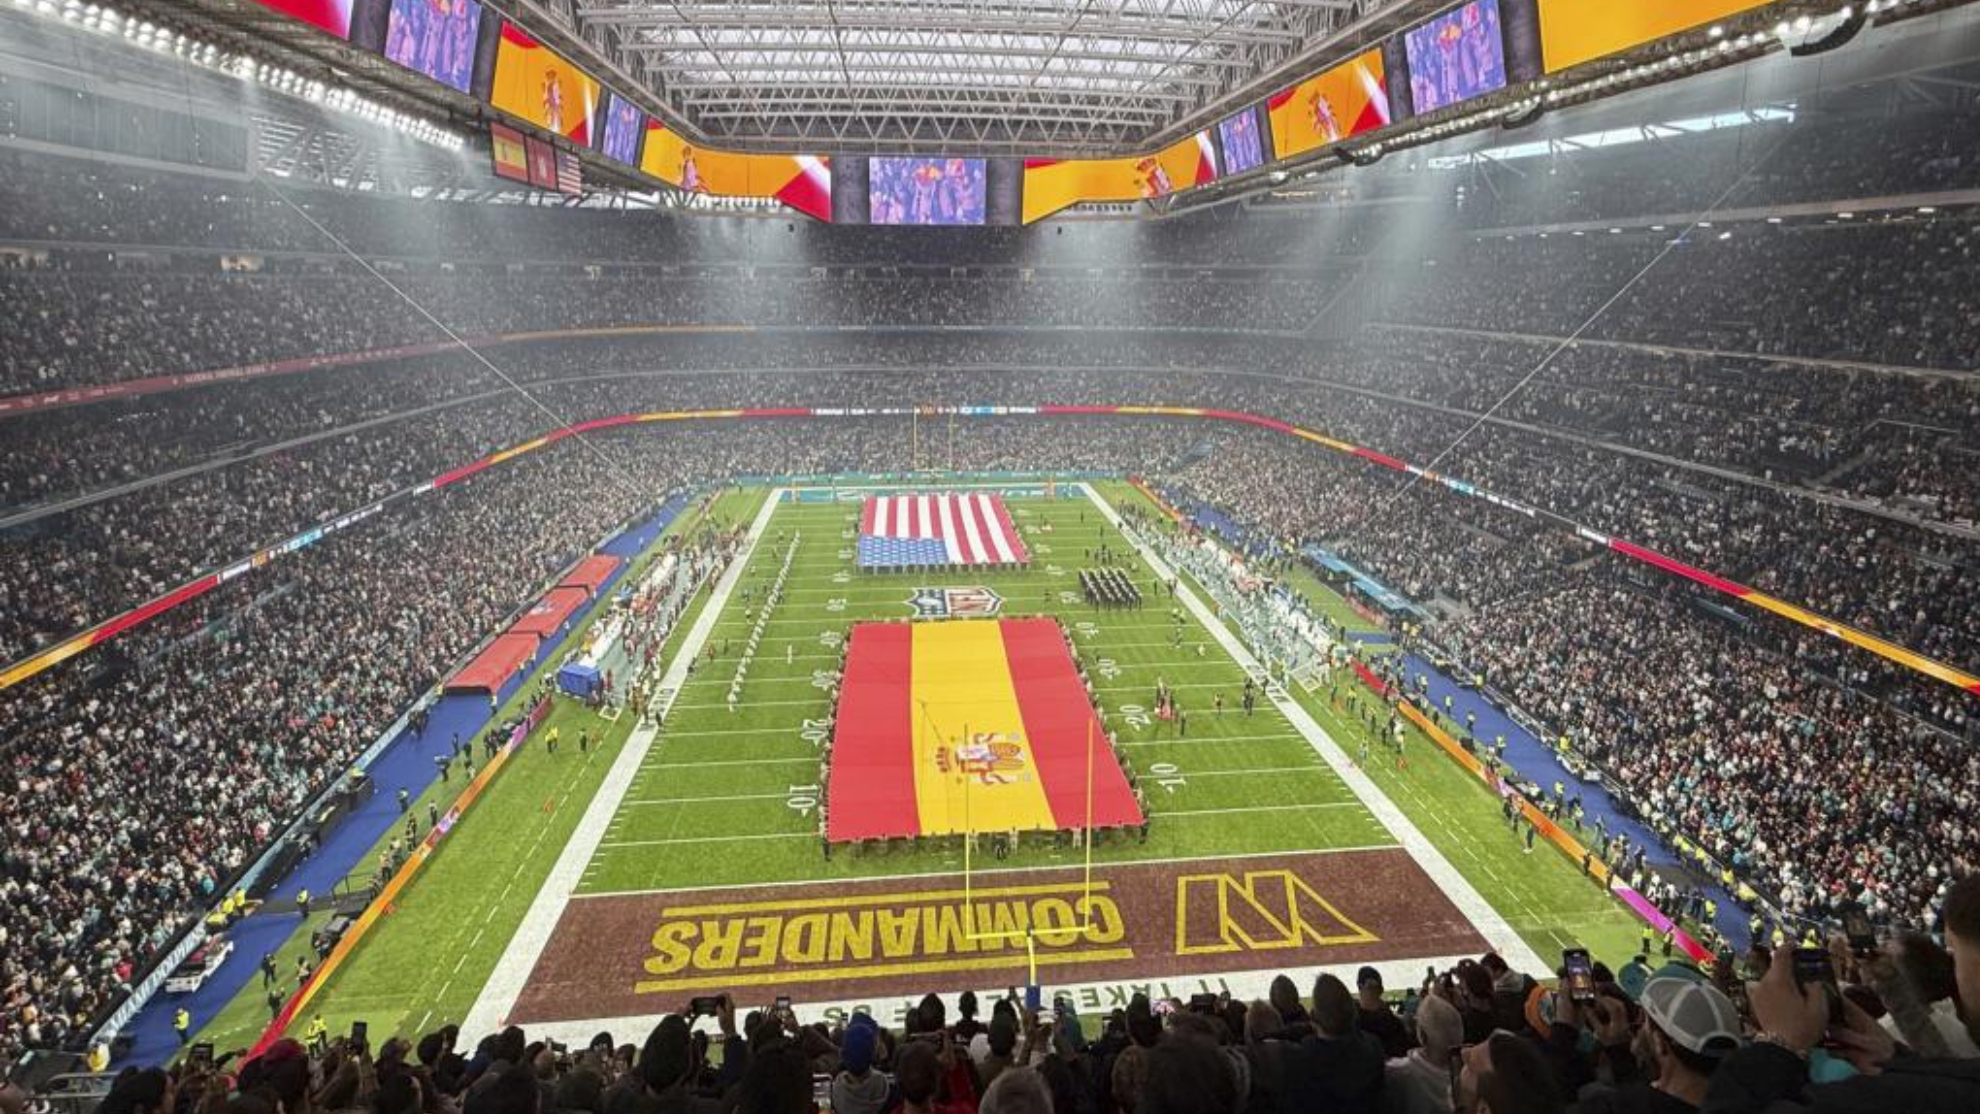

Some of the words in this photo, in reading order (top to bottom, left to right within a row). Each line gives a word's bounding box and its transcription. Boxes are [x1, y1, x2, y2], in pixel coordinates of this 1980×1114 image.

[1119, 705, 1151, 725] 20
[800, 719, 828, 740] 20
[1150, 763, 1186, 786] 10
[787, 784, 818, 808] 10
[644, 893, 1126, 976] COMMANDERS
